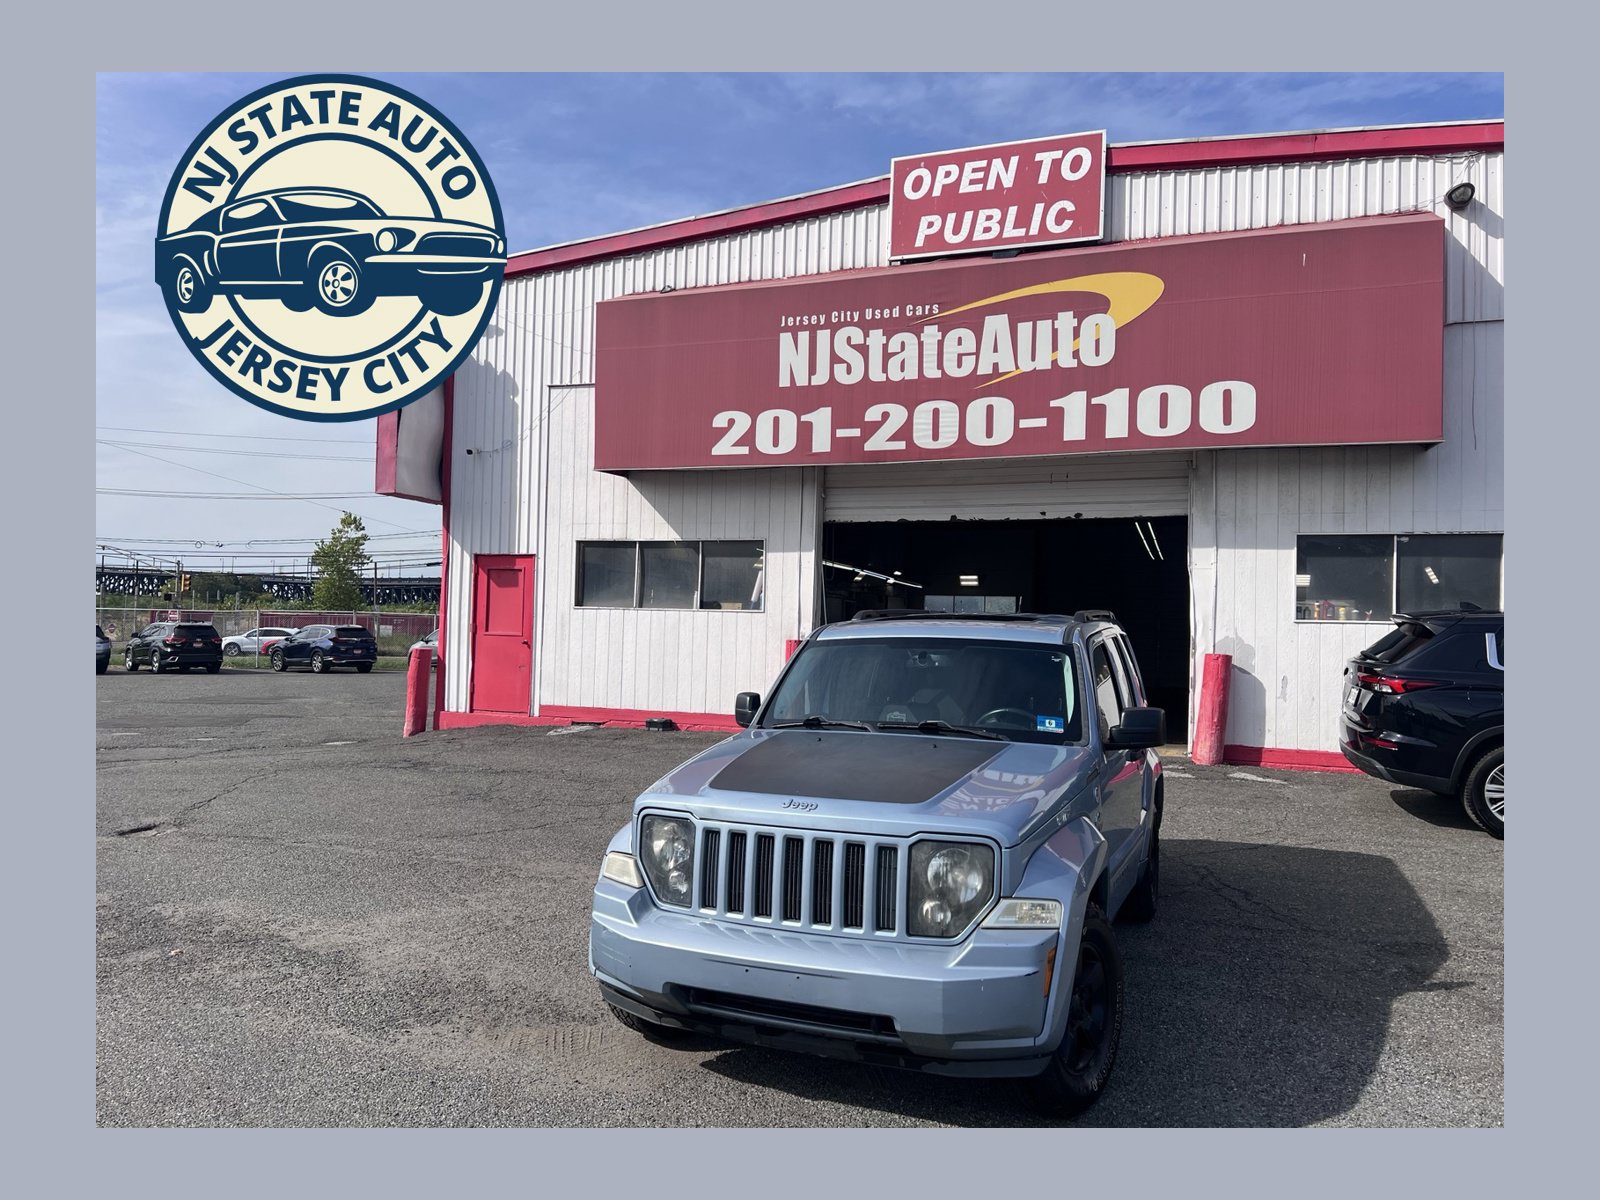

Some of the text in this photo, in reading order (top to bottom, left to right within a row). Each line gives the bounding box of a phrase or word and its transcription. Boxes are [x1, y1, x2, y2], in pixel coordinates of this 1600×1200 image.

[903, 146, 1093, 201] OPEN TO
[914, 199, 1076, 249] PUBLIC
[780, 303, 939, 327] Jersey City Used Cars
[778, 309, 1117, 388] NJStateAuto
[711, 380, 1257, 456] 201-200-1100
[782, 798, 819, 813] Jeep
